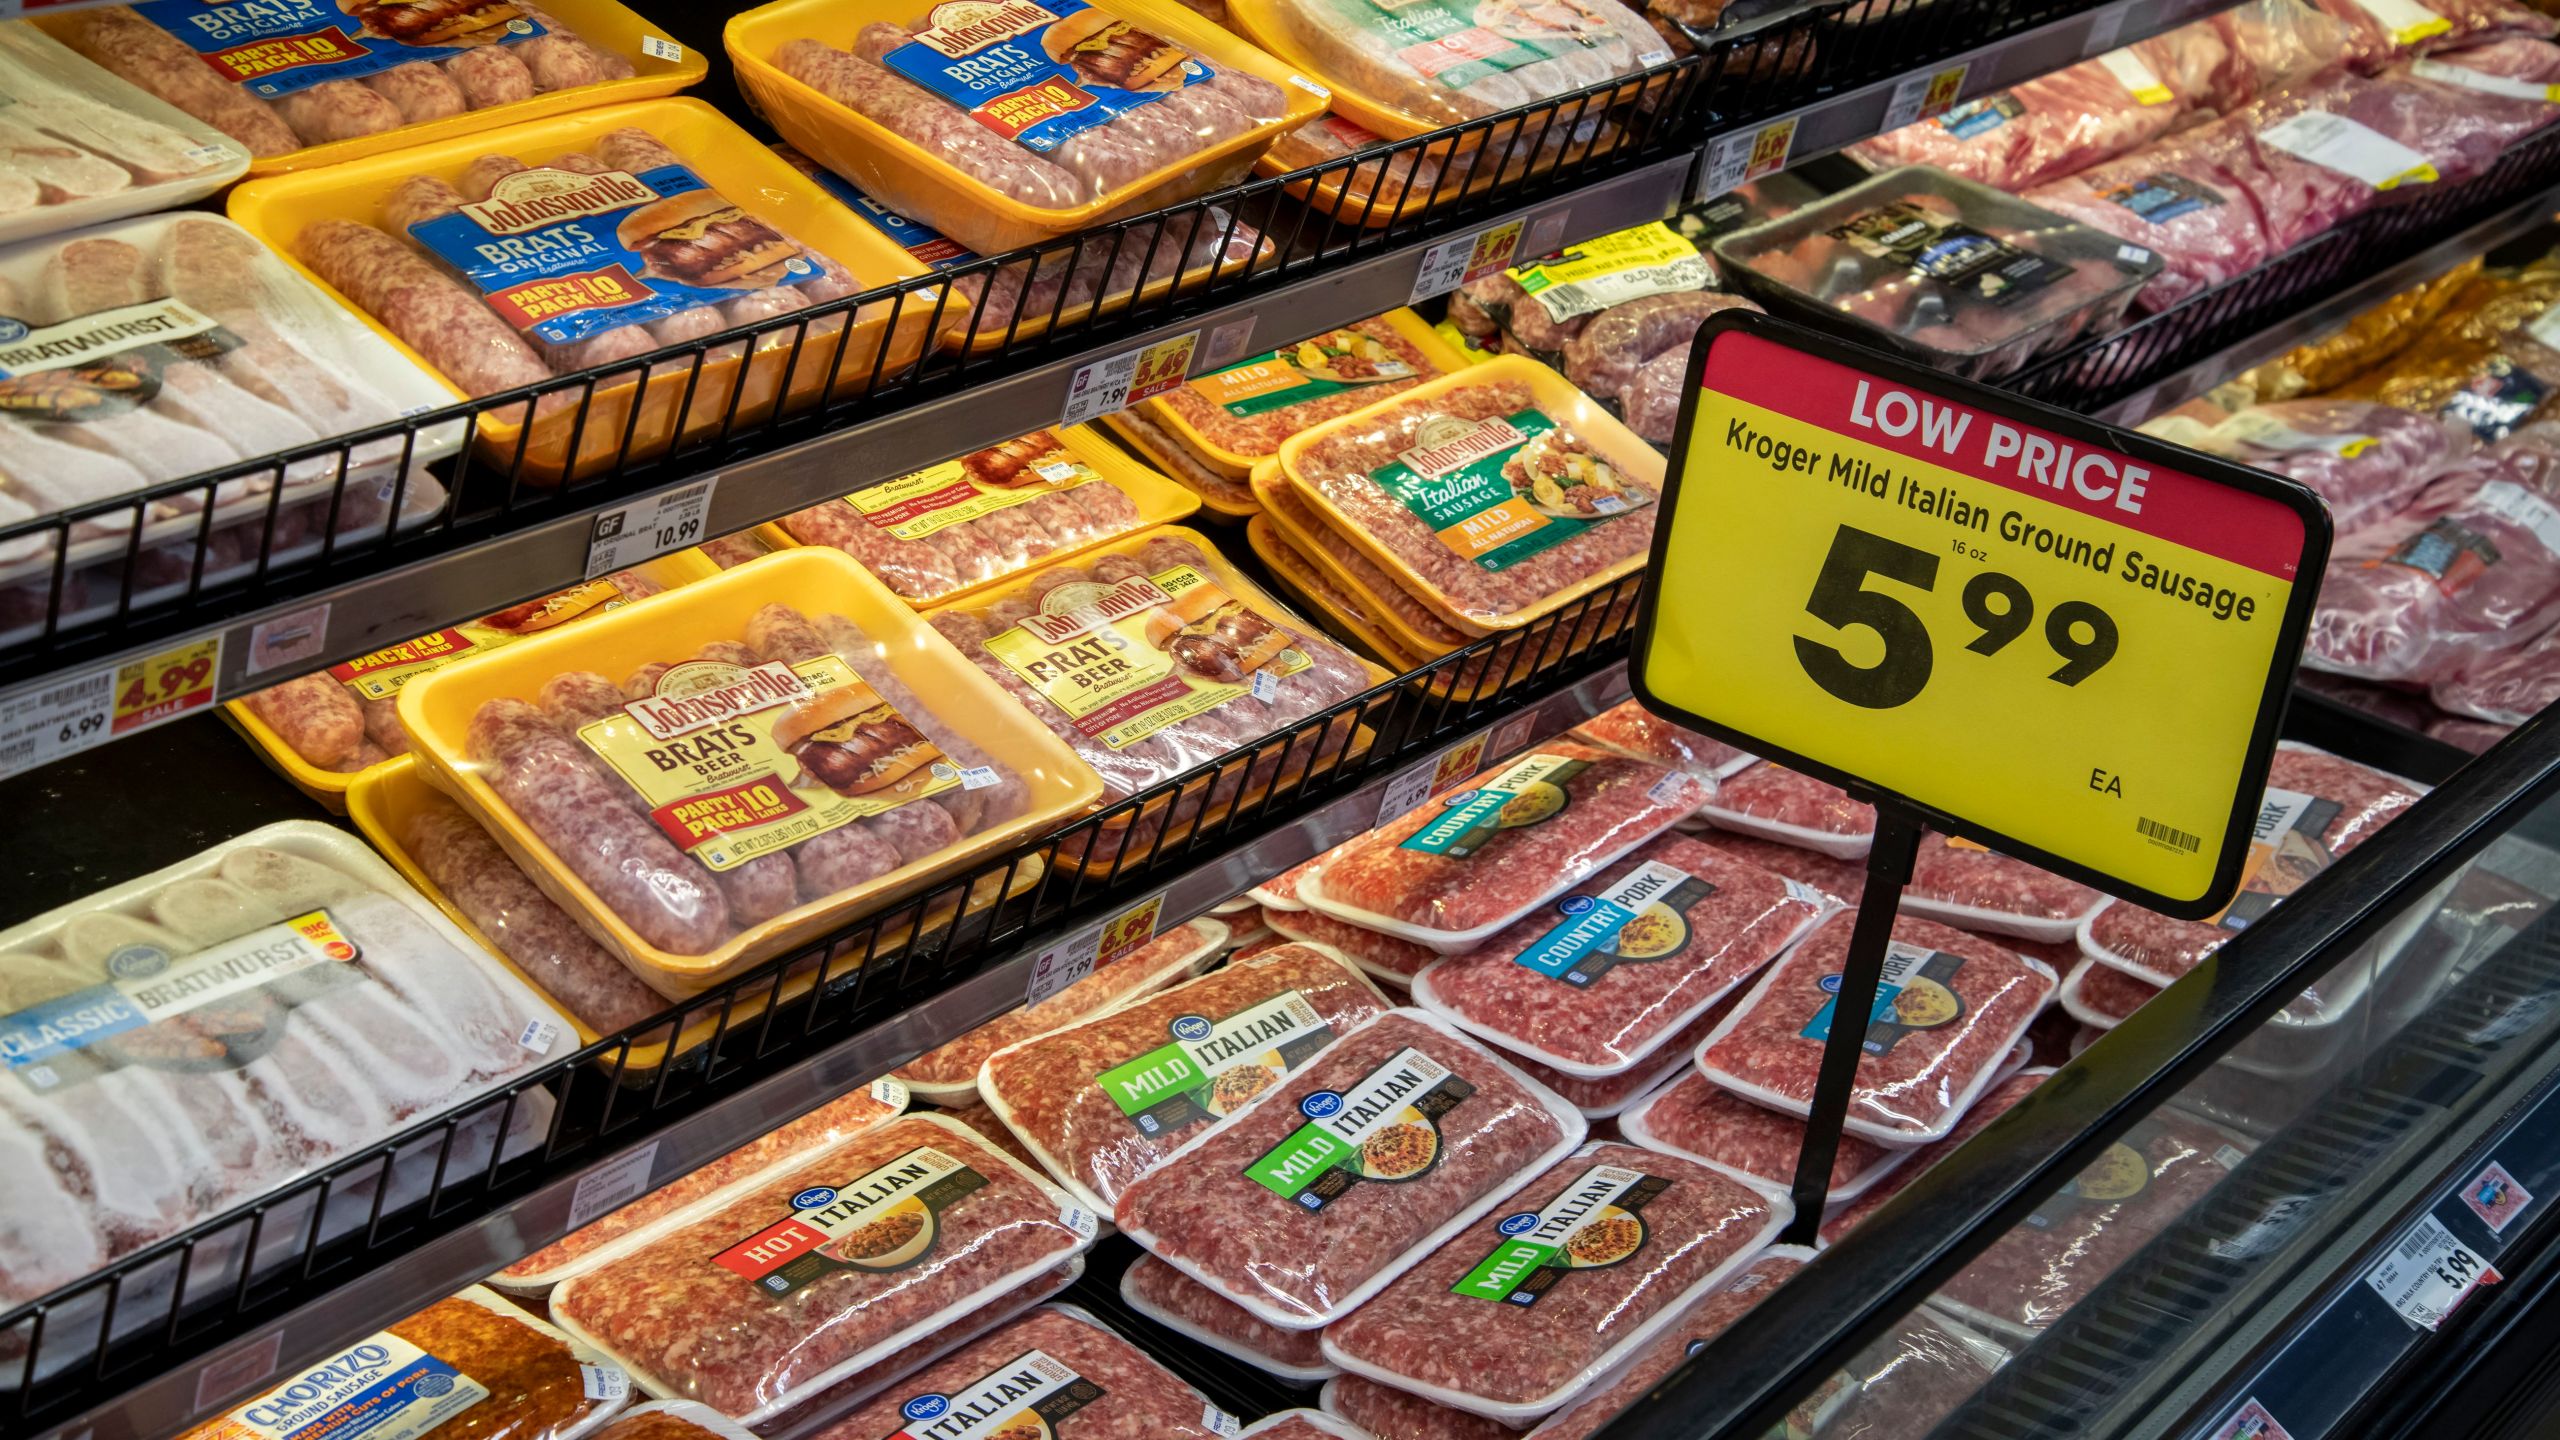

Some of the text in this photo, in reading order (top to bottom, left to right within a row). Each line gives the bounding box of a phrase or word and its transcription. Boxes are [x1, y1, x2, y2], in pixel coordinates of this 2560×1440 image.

[187, 0, 313, 33] BRATS
[211, 4, 327, 41] ORIGINAL
[1371, 4, 1455, 35] Italian
[219, 41, 293, 67] PARTY
[293, 36, 338, 60] 10
[313, 50, 347, 61] LINKS
[1429, 33, 1472, 54] HOT
[233, 52, 307, 77] PACK
[942, 43, 1031, 85] BRATS
[969, 56, 1045, 91] ORIGINAL
[987, 93, 1038, 120] PARTY
[1002, 103, 1050, 130] PACK
[474, 176, 649, 232] Johnsonville
[474, 223, 596, 265] BRATS
[501, 240, 610, 273] ORIGINAL
[582, 275, 624, 299] 10
[1441, 266, 1464, 286] 7.99
[1624, 269, 1649, 284] OLD
[507, 280, 577, 308] PARTY
[521, 292, 596, 320] PACK
[600, 291, 633, 304] LINKS
[1, 315, 177, 368] BRATWURST
[1075, 373, 1089, 389] GF
[1135, 348, 1189, 387] 5.49
[1219, 365, 1272, 388] MILD
[1100, 386, 1128, 407] 7.99
[1142, 381, 1169, 398] SALE
[1223, 375, 1293, 399] ALL NATURAL
[1408, 422, 1520, 475] Johnsonville
[1850, 380, 2151, 515] LOW PRICE
[884, 477, 924, 494] Bratwurst
[1418, 470, 1489, 511] Italian
[1434, 485, 1502, 521] SAUSAGE
[598, 516, 620, 537] GF
[1461, 508, 1512, 539] MILD
[1470, 516, 1536, 551] ALL NATURAL
[1726, 417, 2257, 623] Kroger Mild Italian Ground Sausage
[604, 523, 658, 547] ORIGINAL BRAT
[655, 518, 700, 550] 10.99
[1951, 537, 1988, 563] 16 oz
[347, 643, 417, 673] PACK
[420, 642, 454, 657] LINKS
[1026, 631, 1130, 684] BRATS
[118, 657, 212, 708] 4.99
[1070, 656, 1133, 689] BEER
[1093, 672, 1134, 694] Bratwurst
[141, 700, 184, 720] SALE
[639, 668, 800, 733] Johnsonville
[1119, 700, 1128, 709] No
[1132, 703, 1141, 711] No
[24, 705, 88, 732] BRATWURST
[58, 712, 105, 743] 6.99
[1078, 706, 1118, 730] ONLY PREMIUM
[1085, 713, 1122, 734] CUTS PORK
[1120, 724, 1142, 739] NET WT
[644, 723, 757, 772] BRATS
[692, 752, 745, 776] BEER
[706, 763, 752, 784] Bratwurst
[1435, 743, 1482, 783] 5.49
[1405, 785, 1428, 806] 6.99
[2089, 767, 2123, 799] EA
[671, 795, 738, 824] PARTY
[738, 784, 781, 812] 10
[756, 803, 789, 820] LINKS
[1421, 762, 1550, 847] COUNTRY PORK
[685, 808, 753, 839] PACK
[729, 842, 744, 857] NET
[743, 838, 757, 852] WT
[300, 919, 330, 938] BIG
[1101, 911, 1155, 954] 6.99
[1537, 873, 1668, 968] COUNTRY PORK
[1110, 942, 1135, 963] SALE
[1065, 957, 1092, 982] 7.99
[1, 936, 308, 1058] CLASSIC BRATWURST
[1285, 1001, 1312, 1027] GROUND
[1177, 1019, 1210, 1038] Kroger
[1120, 1009, 1298, 1101] MILD ITALIAN
[1412, 1053, 1444, 1077] SAUSAGE
[1405, 1058, 1438, 1081] GROUND
[1308, 1095, 1336, 1114] Kroger
[1269, 1068, 1424, 1185] MILD ITALIAN
[916, 1154, 951, 1172] GROUND
[798, 1190, 832, 1209] Kroger
[742, 1163, 931, 1265] HOT ITALIAN
[1506, 1215, 1533, 1233] Kroger
[1476, 1180, 1618, 1291] MILD ITALIAN
[768, 1275, 783, 1289] 170
[2436, 1249, 2480, 1290] 5.99
[2376, 1279, 2387, 1291] 47
[2395, 1270, 2431, 1309] KRO BULK COUNTRY
[1029, 1360, 1064, 1383] GROUND
[1035, 1356, 1072, 1378] SAUSAGE
[245, 1344, 394, 1427] CHORIZO
[350, 1367, 431, 1417] CUTS OF PORK
[276, 1401, 330, 1433] GROUND
[330, 1368, 384, 1404] SAUSAGE
[323, 1402, 356, 1424] WITH
[911, 1395, 942, 1416] Kroger
[922, 1370, 1045, 1440] ITALIAN
